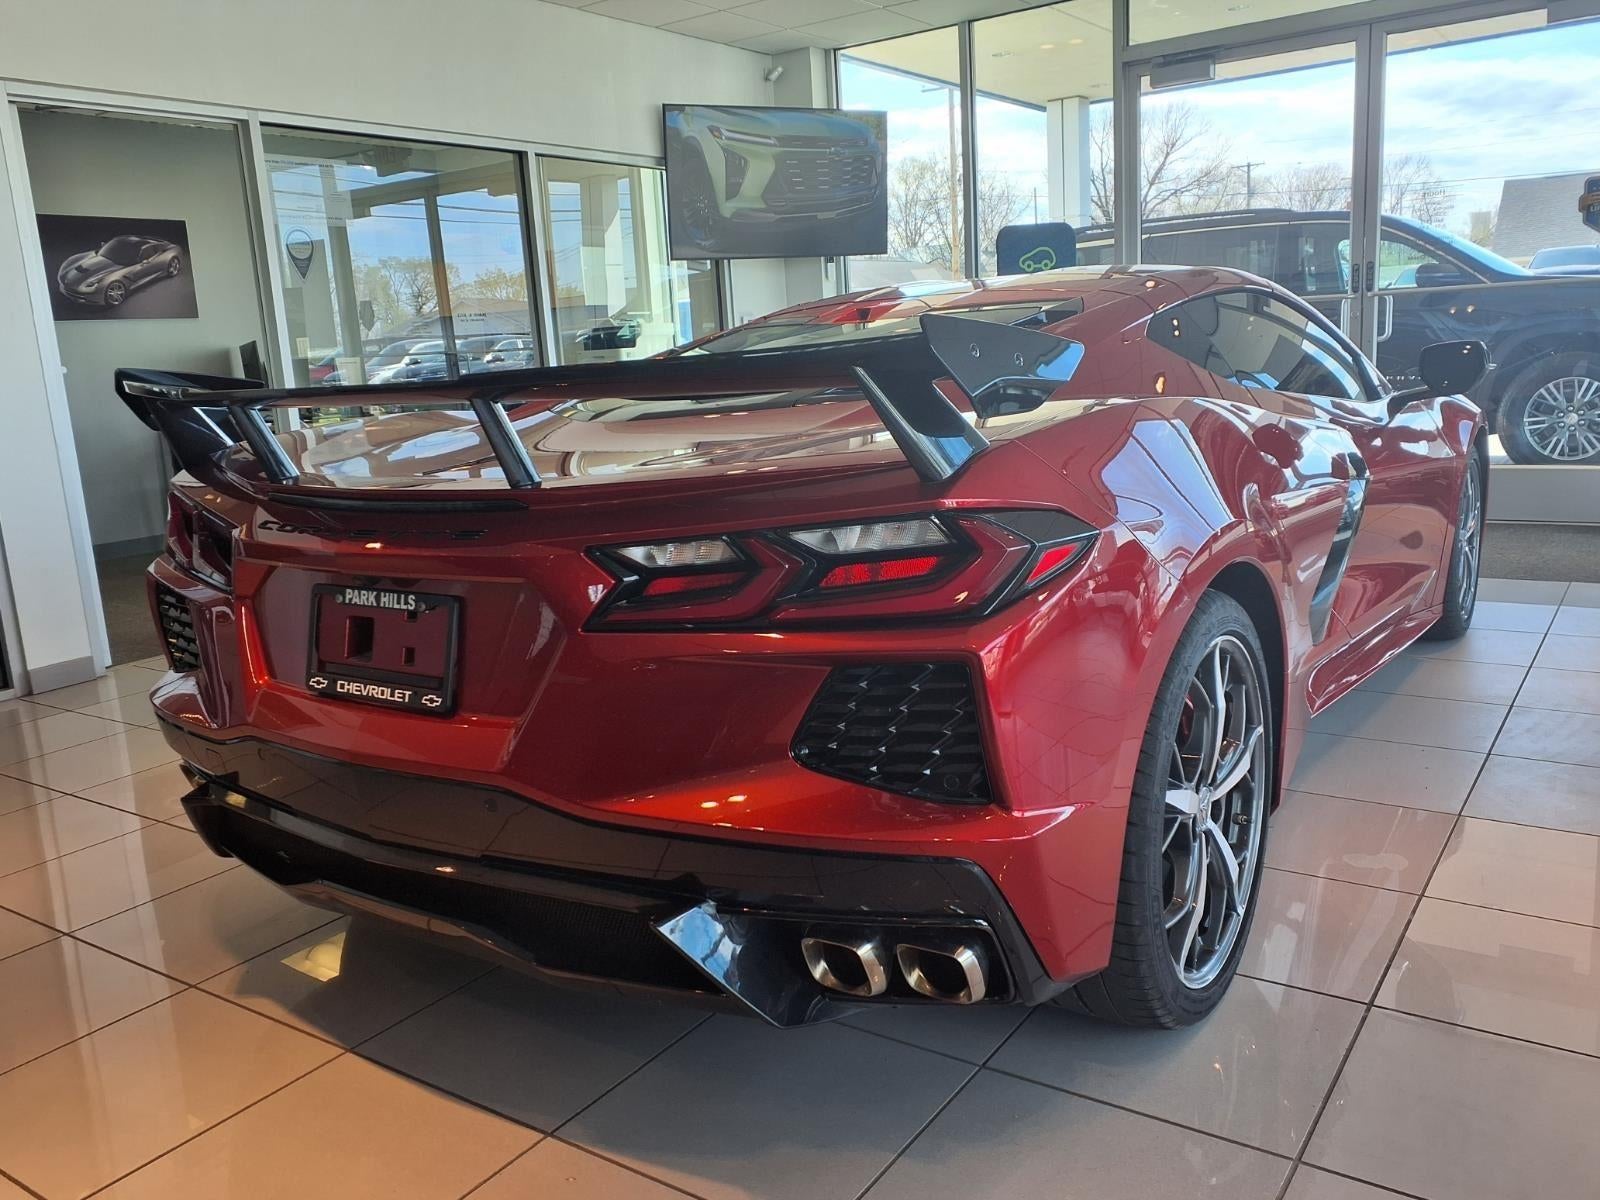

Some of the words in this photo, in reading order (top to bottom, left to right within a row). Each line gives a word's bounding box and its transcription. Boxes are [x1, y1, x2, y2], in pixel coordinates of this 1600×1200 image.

[257, 519, 489, 541] COREE
[345, 588, 378, 606] PARK
[380, 591, 416, 610] HILLS
[336, 680, 413, 703] CHEVROLET
